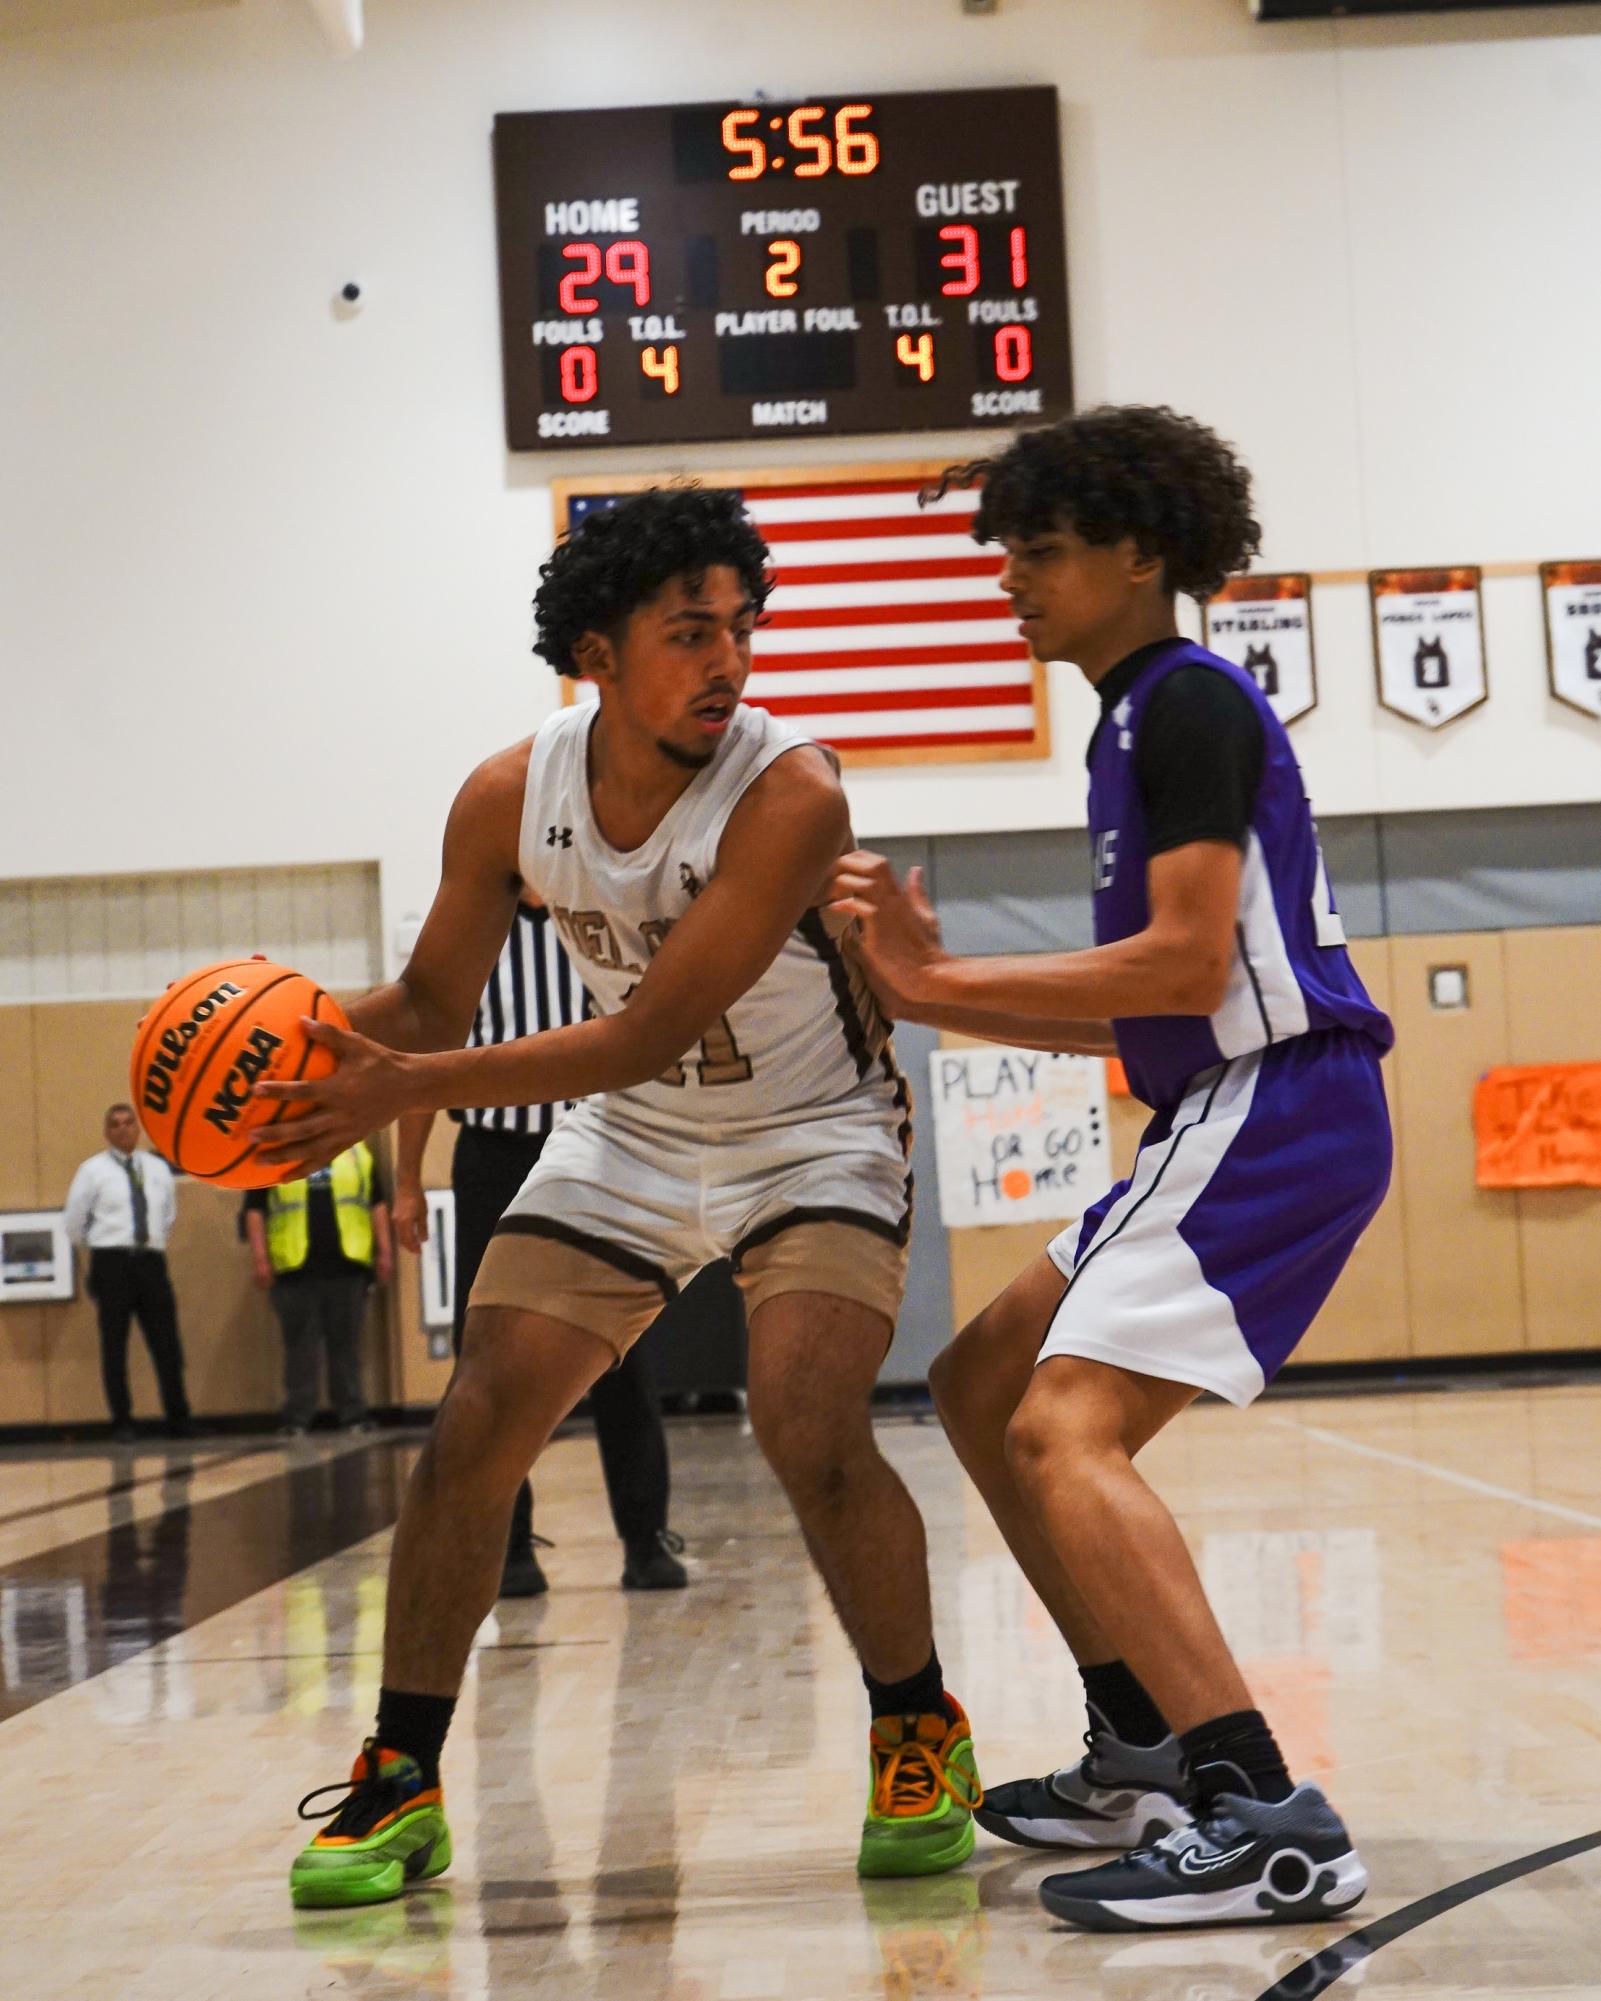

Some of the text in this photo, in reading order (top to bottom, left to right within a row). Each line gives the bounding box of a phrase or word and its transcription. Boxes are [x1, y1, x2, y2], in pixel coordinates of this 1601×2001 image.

[722, 104, 879, 180] 5:56
[545, 198, 639, 236] HOME
[916, 180, 1020, 218] GUEST
[741, 208, 820, 235] PERIOD
[559, 240, 650, 314] 29
[765, 239, 801, 297] 2
[939, 224, 1028, 296] 31
[628, 314, 686, 341] T.O.L.
[715, 306, 860, 337] PLAYER FOUL
[885, 303, 942, 328] T.O.L.
[968, 298, 1039, 325] FOULS
[532, 319, 604, 346] FOULS
[641, 345, 680, 394] 4
[896, 333, 934, 382] 4
[994, 324, 1032, 382] 0
[560, 345, 597, 403] 0
[752, 400, 827, 426] MATCH
[971, 390, 1042, 416] SCORE
[538, 410, 610, 437] SCORE
[144, 982, 248, 1114] Wilson
[204, 1026, 284, 1136] NCAA
[941, 1055, 1040, 1100] PLAY
[992, 1128, 1083, 1165] OR GO
